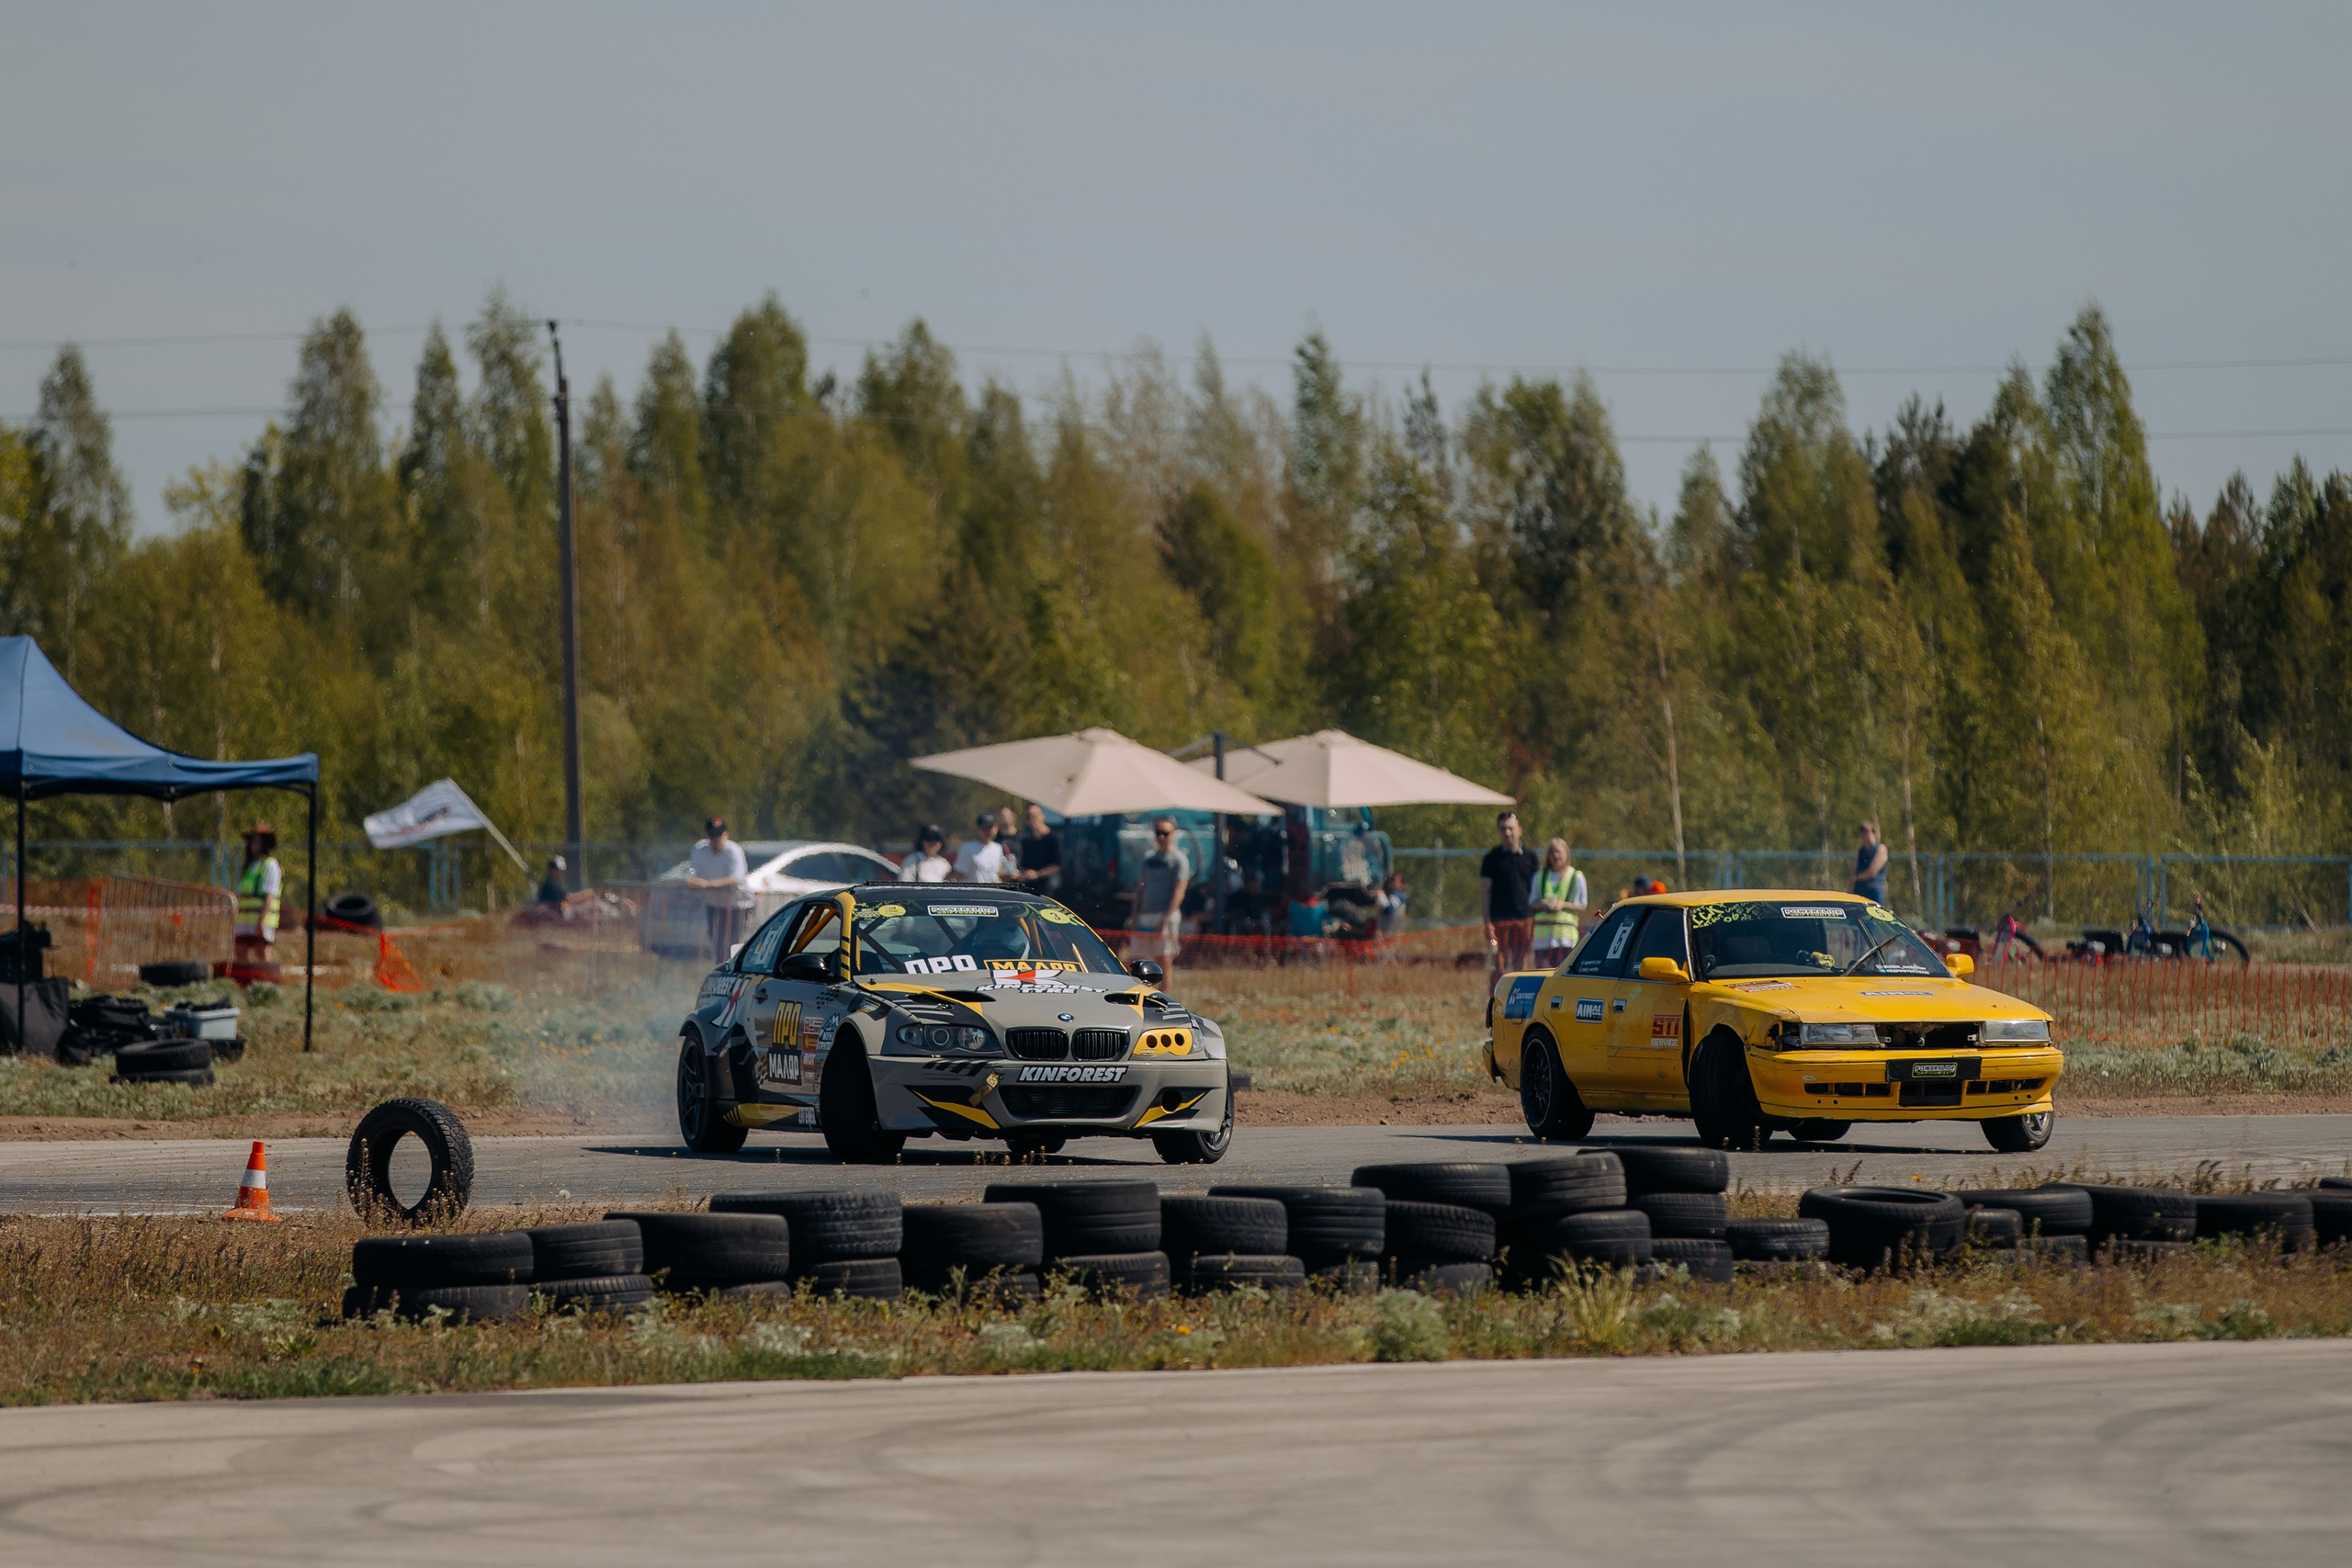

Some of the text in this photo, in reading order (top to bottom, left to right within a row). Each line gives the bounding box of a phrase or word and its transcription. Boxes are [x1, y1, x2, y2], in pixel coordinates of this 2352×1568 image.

[904, 954, 978, 975] ПРО
[976, 983, 1109, 994] KINFOREST
[1577, 1003, 1601, 1018] AIMOL
[773, 1002, 802, 1045] ПРО
[1652, 1017, 1681, 1036] STI
[1650, 1038, 1679, 1047] SERVICE
[769, 1053, 799, 1080] МАЛЯР
[1019, 1066, 1126, 1082] KINFOREST
